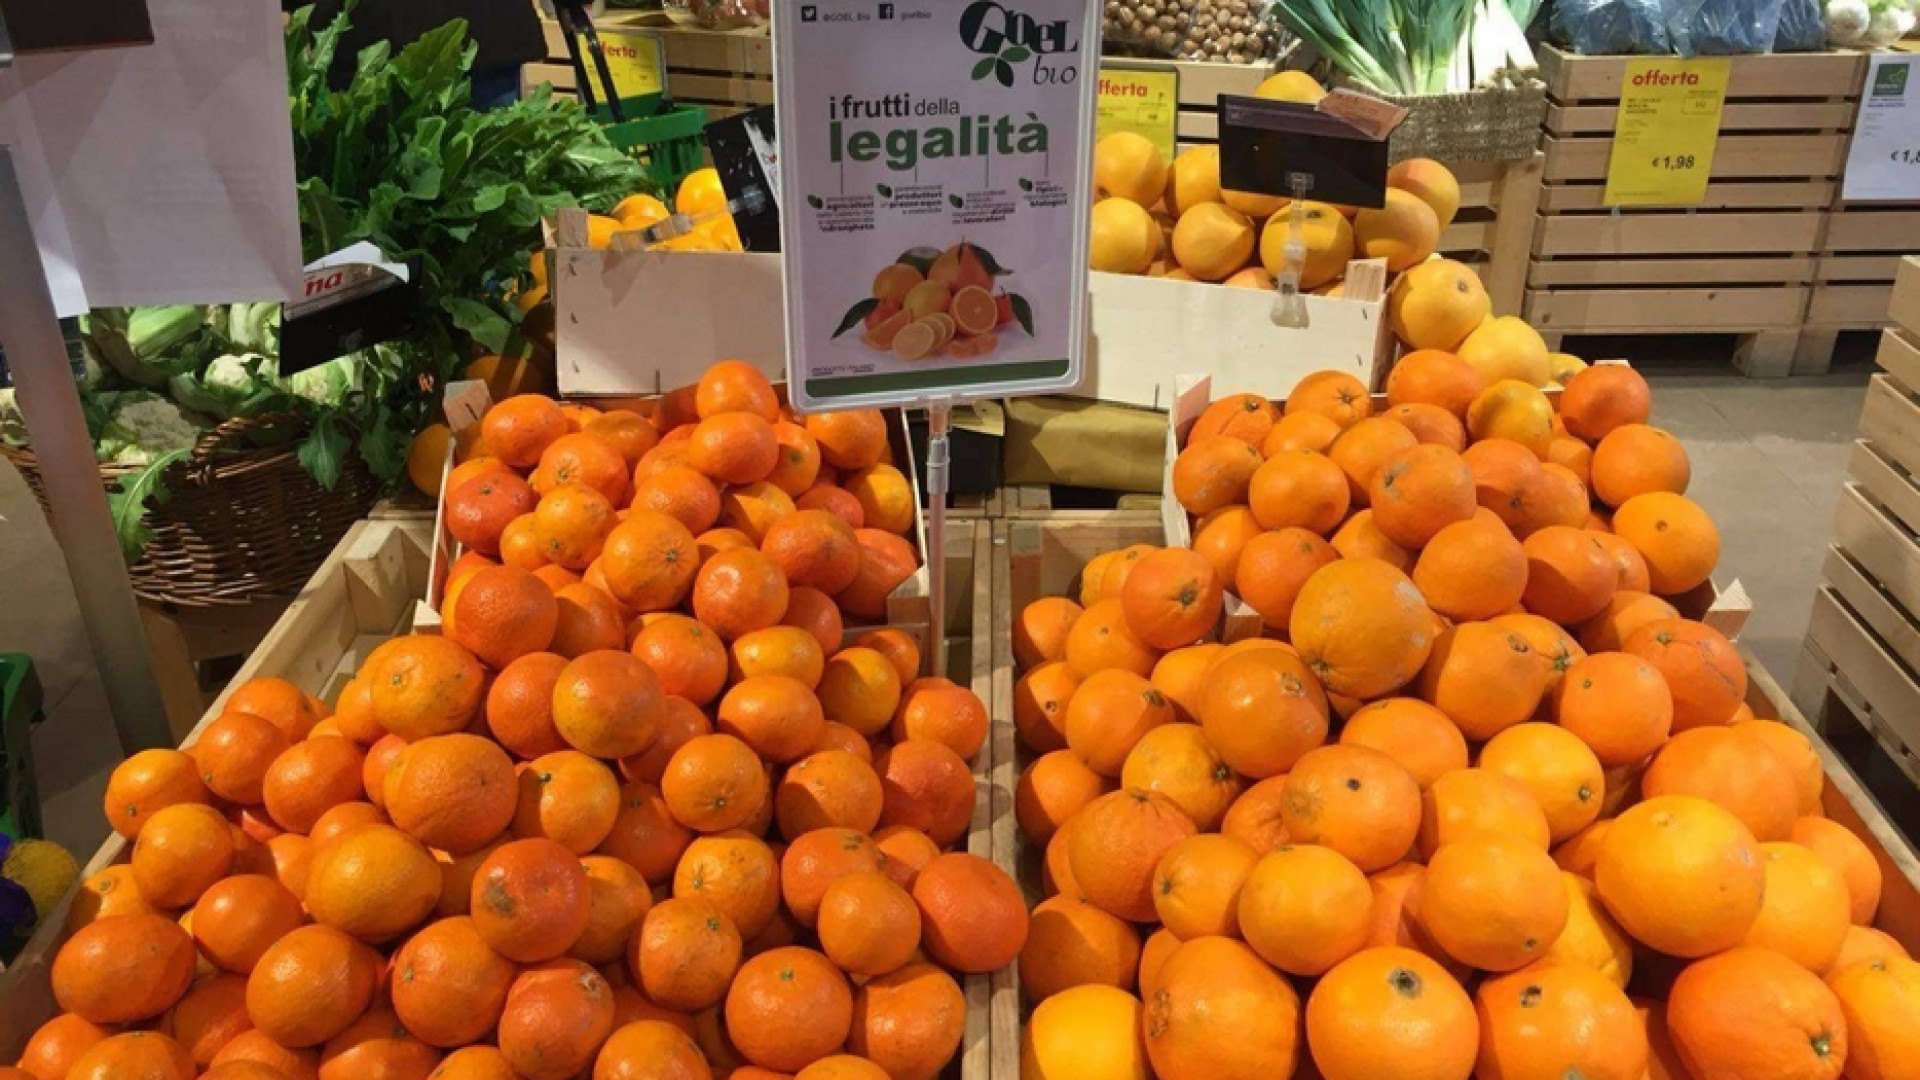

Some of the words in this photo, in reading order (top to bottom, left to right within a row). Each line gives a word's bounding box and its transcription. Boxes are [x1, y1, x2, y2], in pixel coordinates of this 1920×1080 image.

[1033, 54, 1077, 85] bio
[1632, 69, 1699, 86] offerta
[1098, 79, 1147, 98] fferta
[829, 96, 836, 119] i
[841, 92, 910, 119] frutti
[914, 98, 960, 116] della
[829, 112, 1048, 171] legalità
